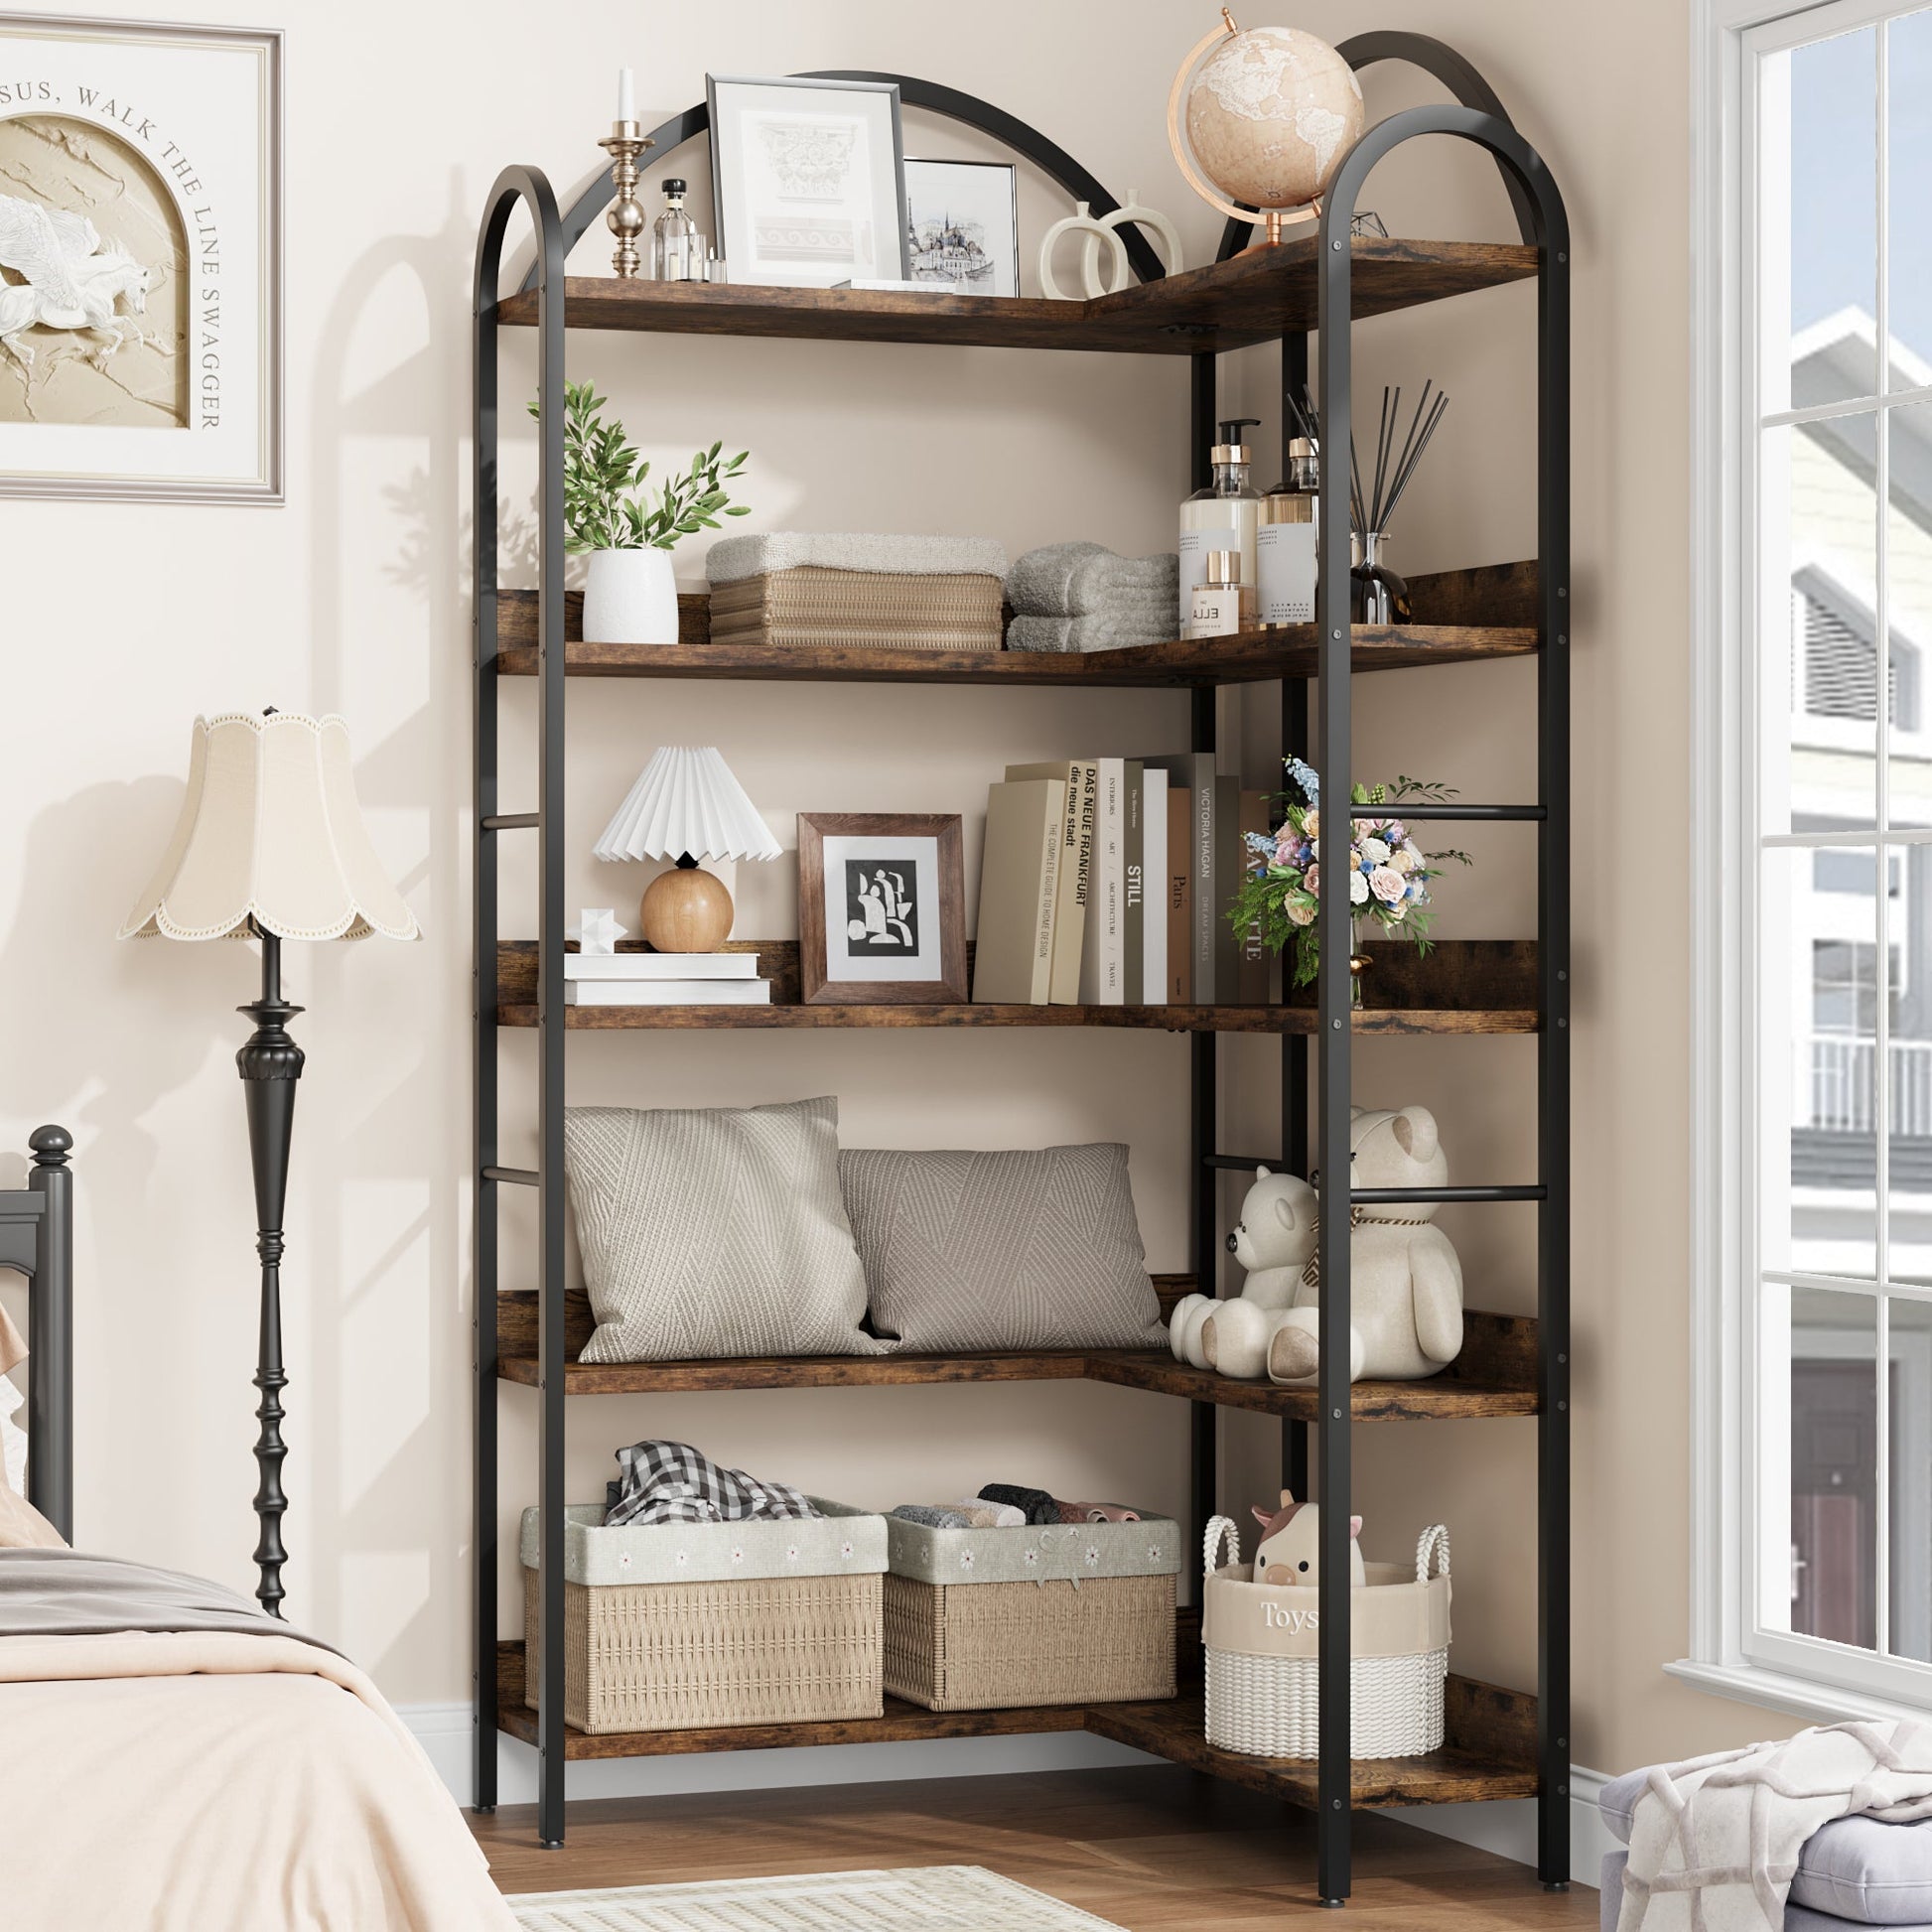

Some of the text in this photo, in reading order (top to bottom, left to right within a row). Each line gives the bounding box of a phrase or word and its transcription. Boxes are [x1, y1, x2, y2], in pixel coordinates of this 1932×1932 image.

[78, 86, 158, 140] WALK
[162, 141, 203, 197] THE
[195, 206, 220, 275] LINE
[202, 288, 220, 430] SWAGGER
[1070, 766, 1081, 783] die
[1200, 787, 1210, 838] VICTORIA
[1065, 817, 1076, 847] stadt
[1076, 768, 1096, 906] DAS NEUE FRANKFURT
[1046, 838, 1056, 875] COMPLETE
[1200, 840, 1210, 879] HAGAN
[1044, 876, 1053, 897] GUIDE
[1127, 865, 1141, 907] STILL
[1173, 875, 1186, 909] Paris
[1041, 909, 1050, 929] HOME
[1039, 931, 1048, 958] DESIGN
[1260, 1601, 1318, 1635] Toys
